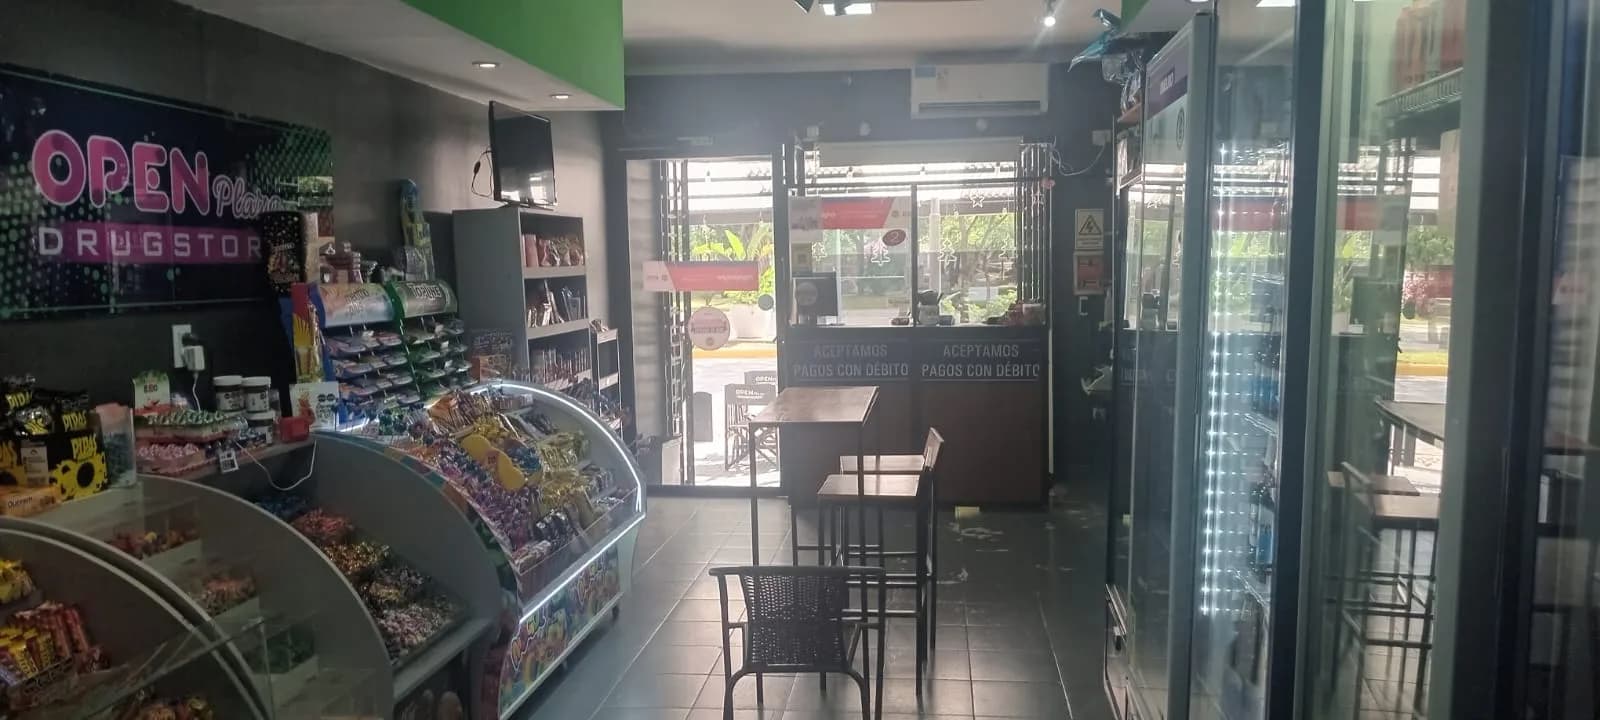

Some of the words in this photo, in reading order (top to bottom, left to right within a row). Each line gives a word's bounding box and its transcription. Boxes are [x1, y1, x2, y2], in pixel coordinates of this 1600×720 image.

[32, 129, 209, 216] OPEN
[39, 226, 262, 259] DRUGSTOR
[814, 344, 887, 358] ACEPTAMOS
[943, 344, 1019, 358] ACEPTAMOS
[793, 363, 833, 377] PAGOS
[837, 363, 858, 377] CON
[866, 361, 908, 377] DÉBITO
[922, 363, 962, 377] PAGOS
[967, 363, 992, 377] CON
[996, 361, 1040, 377] DÉBITO
[70, 433, 98, 459] PIDAS
